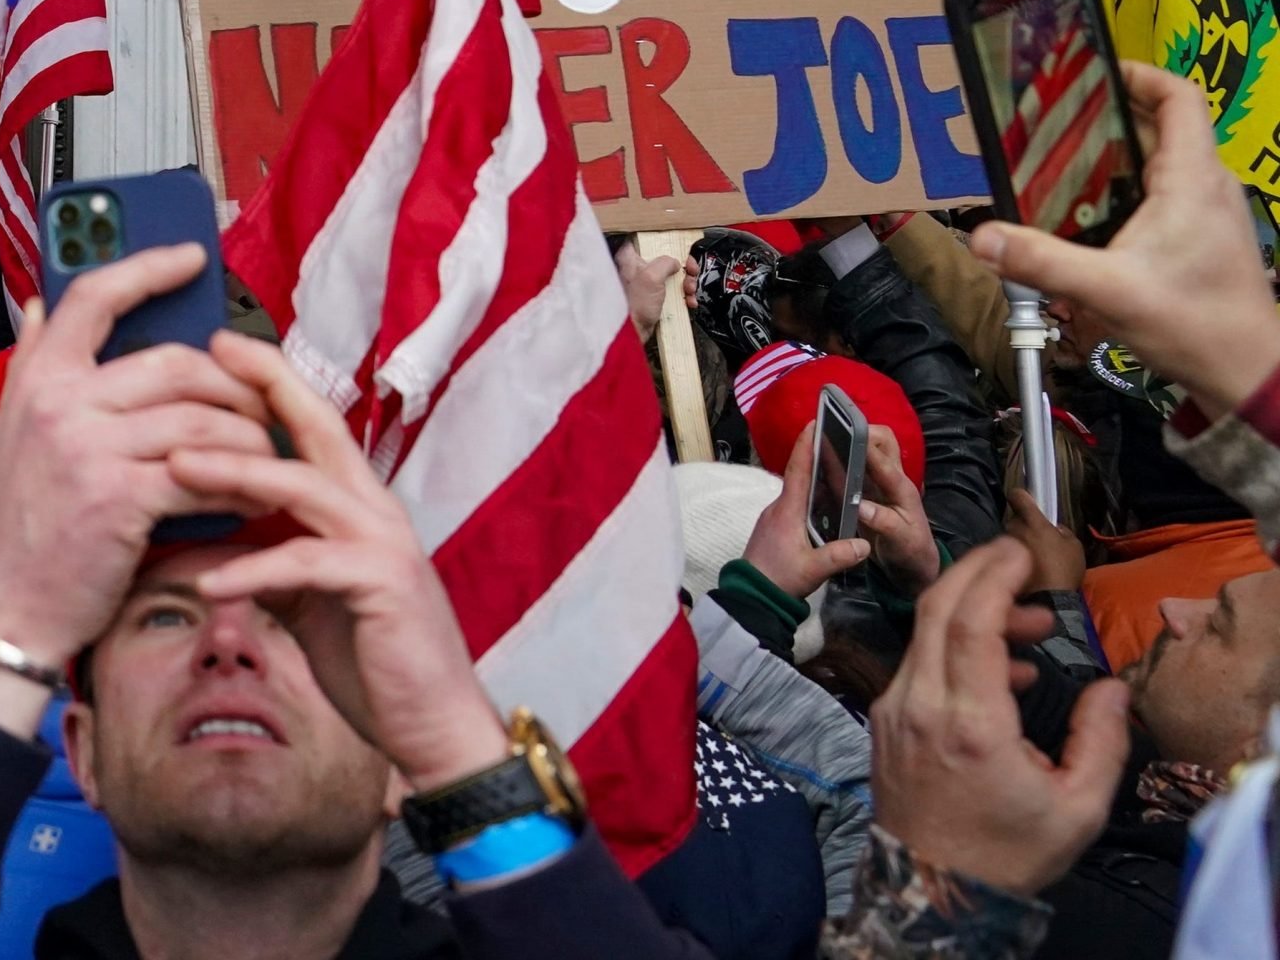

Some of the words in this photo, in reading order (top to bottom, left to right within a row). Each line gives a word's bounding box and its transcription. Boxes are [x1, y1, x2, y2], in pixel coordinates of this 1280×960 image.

[209, 16, 739, 206] NER
[727, 15, 993, 215] JOE
[1090, 359, 1134, 391] PRESIDENT
